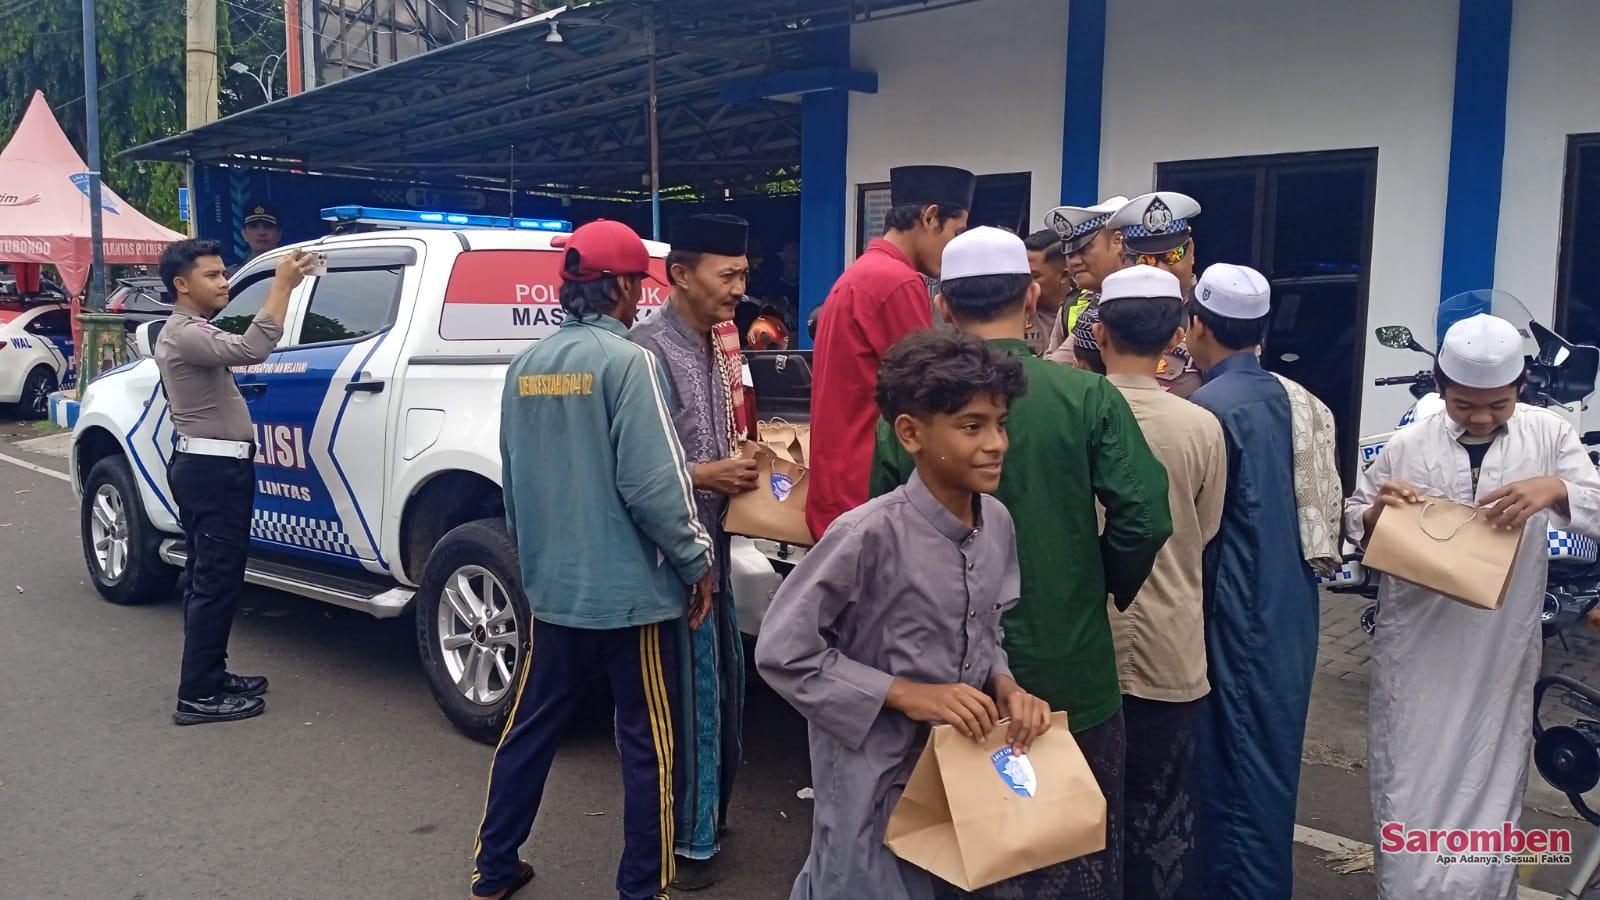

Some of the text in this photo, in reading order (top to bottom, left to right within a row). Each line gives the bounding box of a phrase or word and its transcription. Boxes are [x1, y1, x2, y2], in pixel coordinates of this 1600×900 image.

[0, 239, 51, 256] TUBONDO
[103, 242, 135, 256] TLANTAS
[515, 284, 559, 303] POL
[252, 423, 306, 469] LISI
[258, 479, 312, 502] LINTAS
